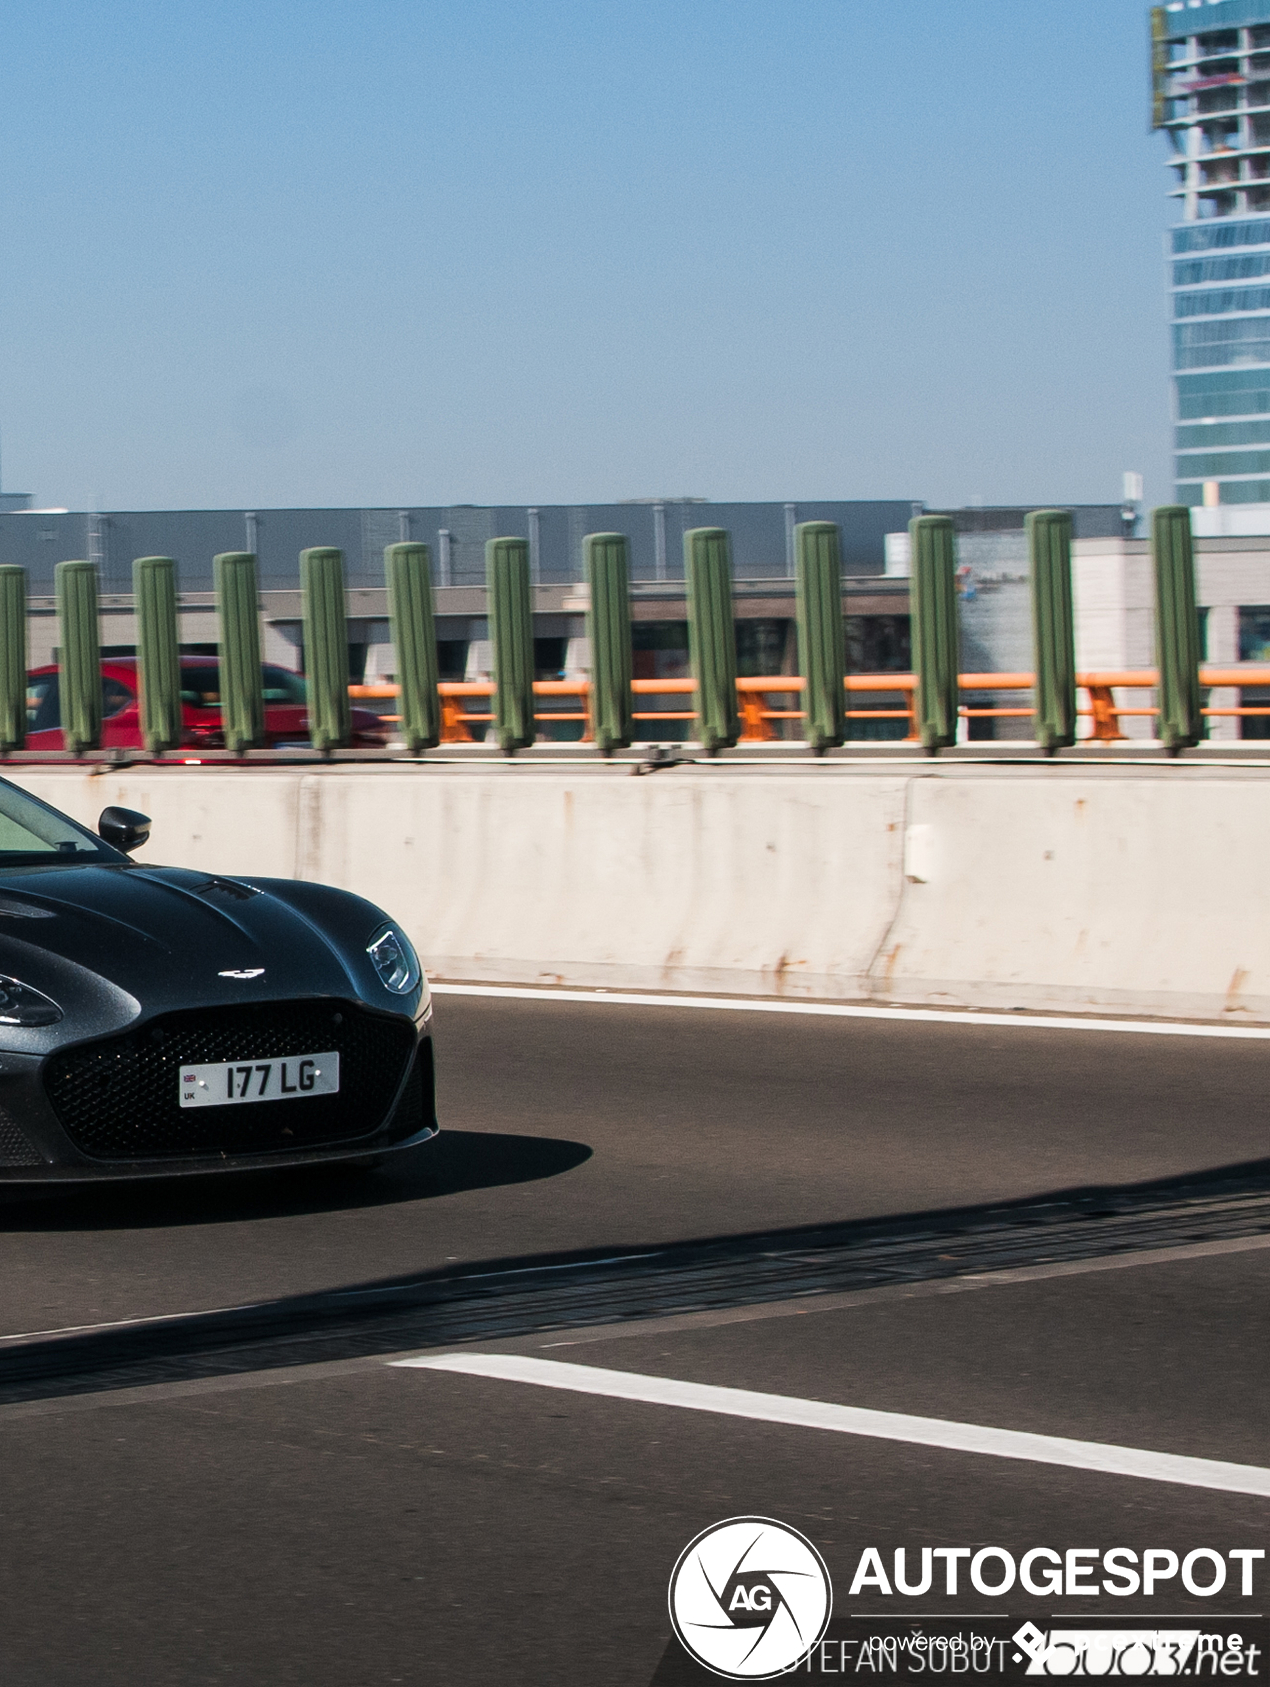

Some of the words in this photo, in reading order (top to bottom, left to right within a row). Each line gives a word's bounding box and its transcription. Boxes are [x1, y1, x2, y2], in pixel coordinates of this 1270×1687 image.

[227, 1064, 272, 1098] 177
[281, 1059, 315, 1093] LG
[184, 1092, 195, 1100] UK
